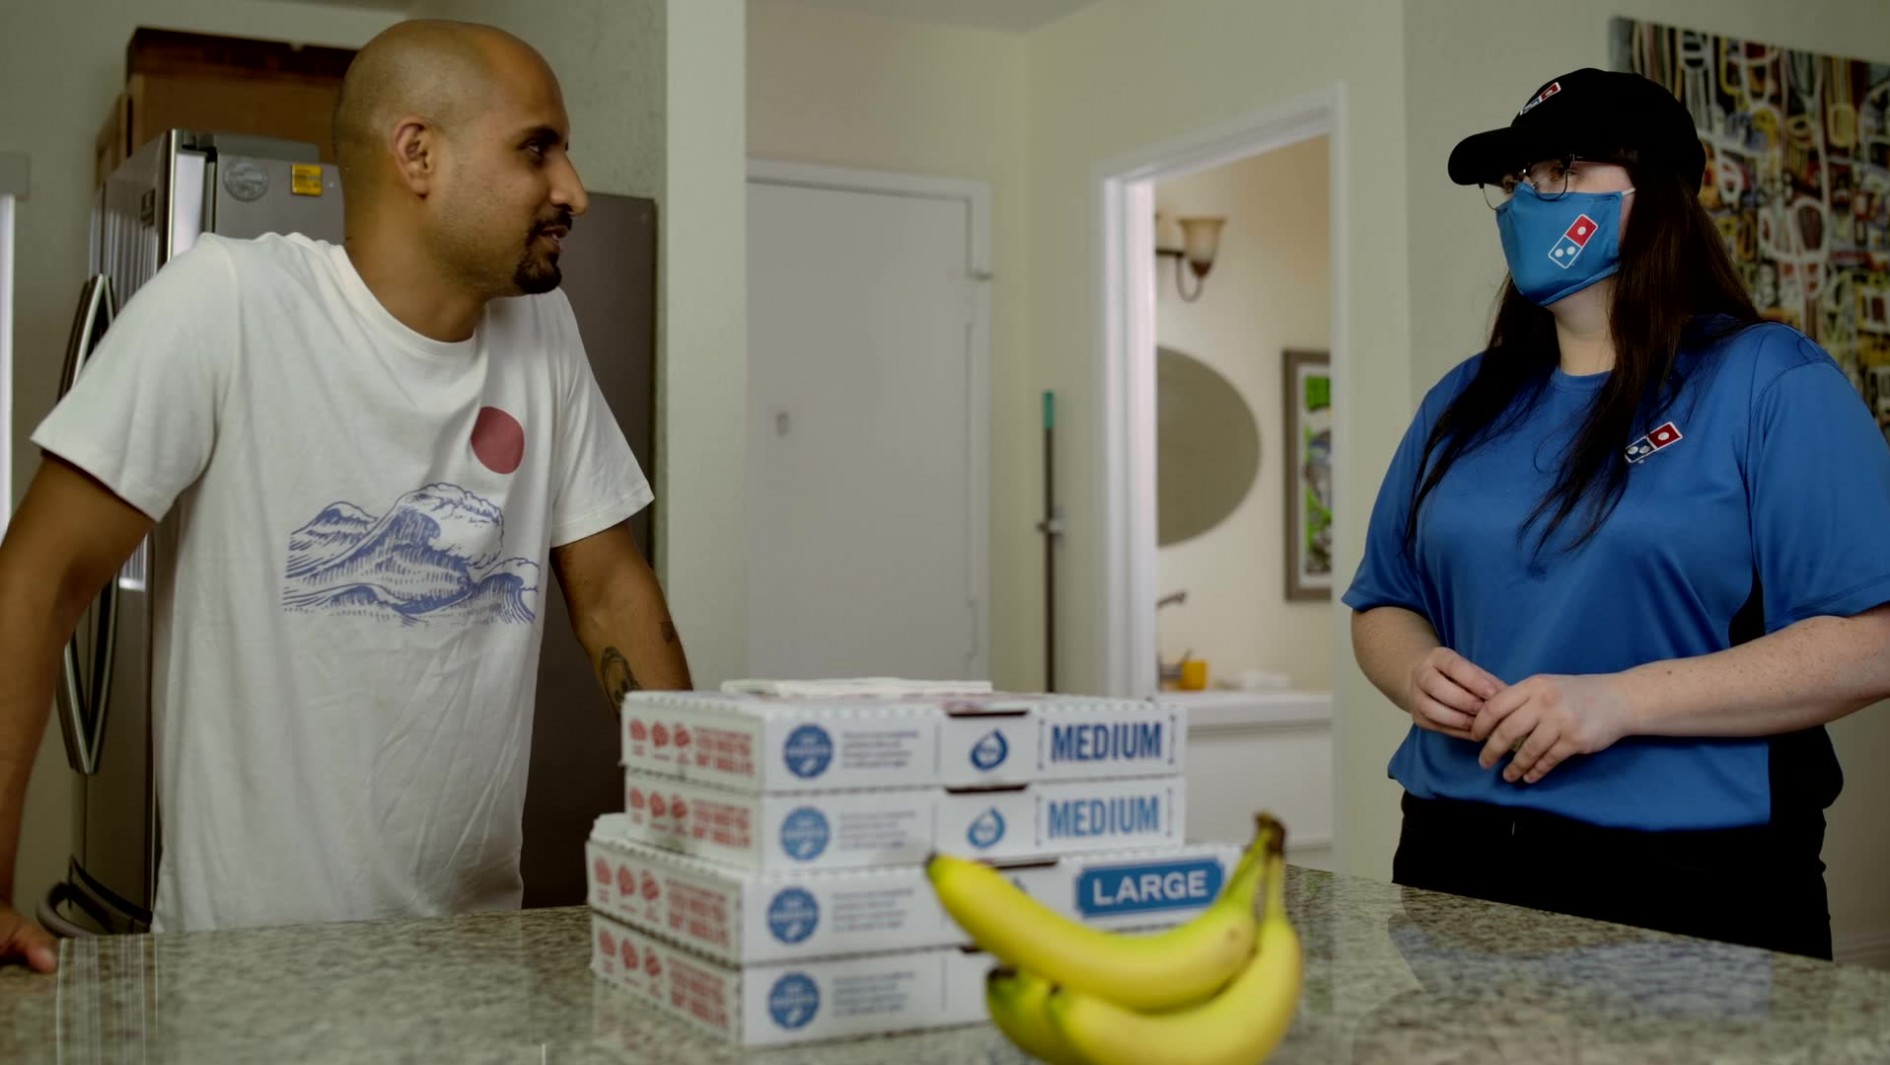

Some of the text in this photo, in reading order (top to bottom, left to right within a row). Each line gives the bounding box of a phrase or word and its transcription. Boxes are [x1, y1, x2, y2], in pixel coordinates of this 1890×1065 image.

[1051, 721, 1162, 763] MEDIUM
[1048, 795, 1159, 839] MEDIUM
[1093, 869, 1208, 906] LARGE
